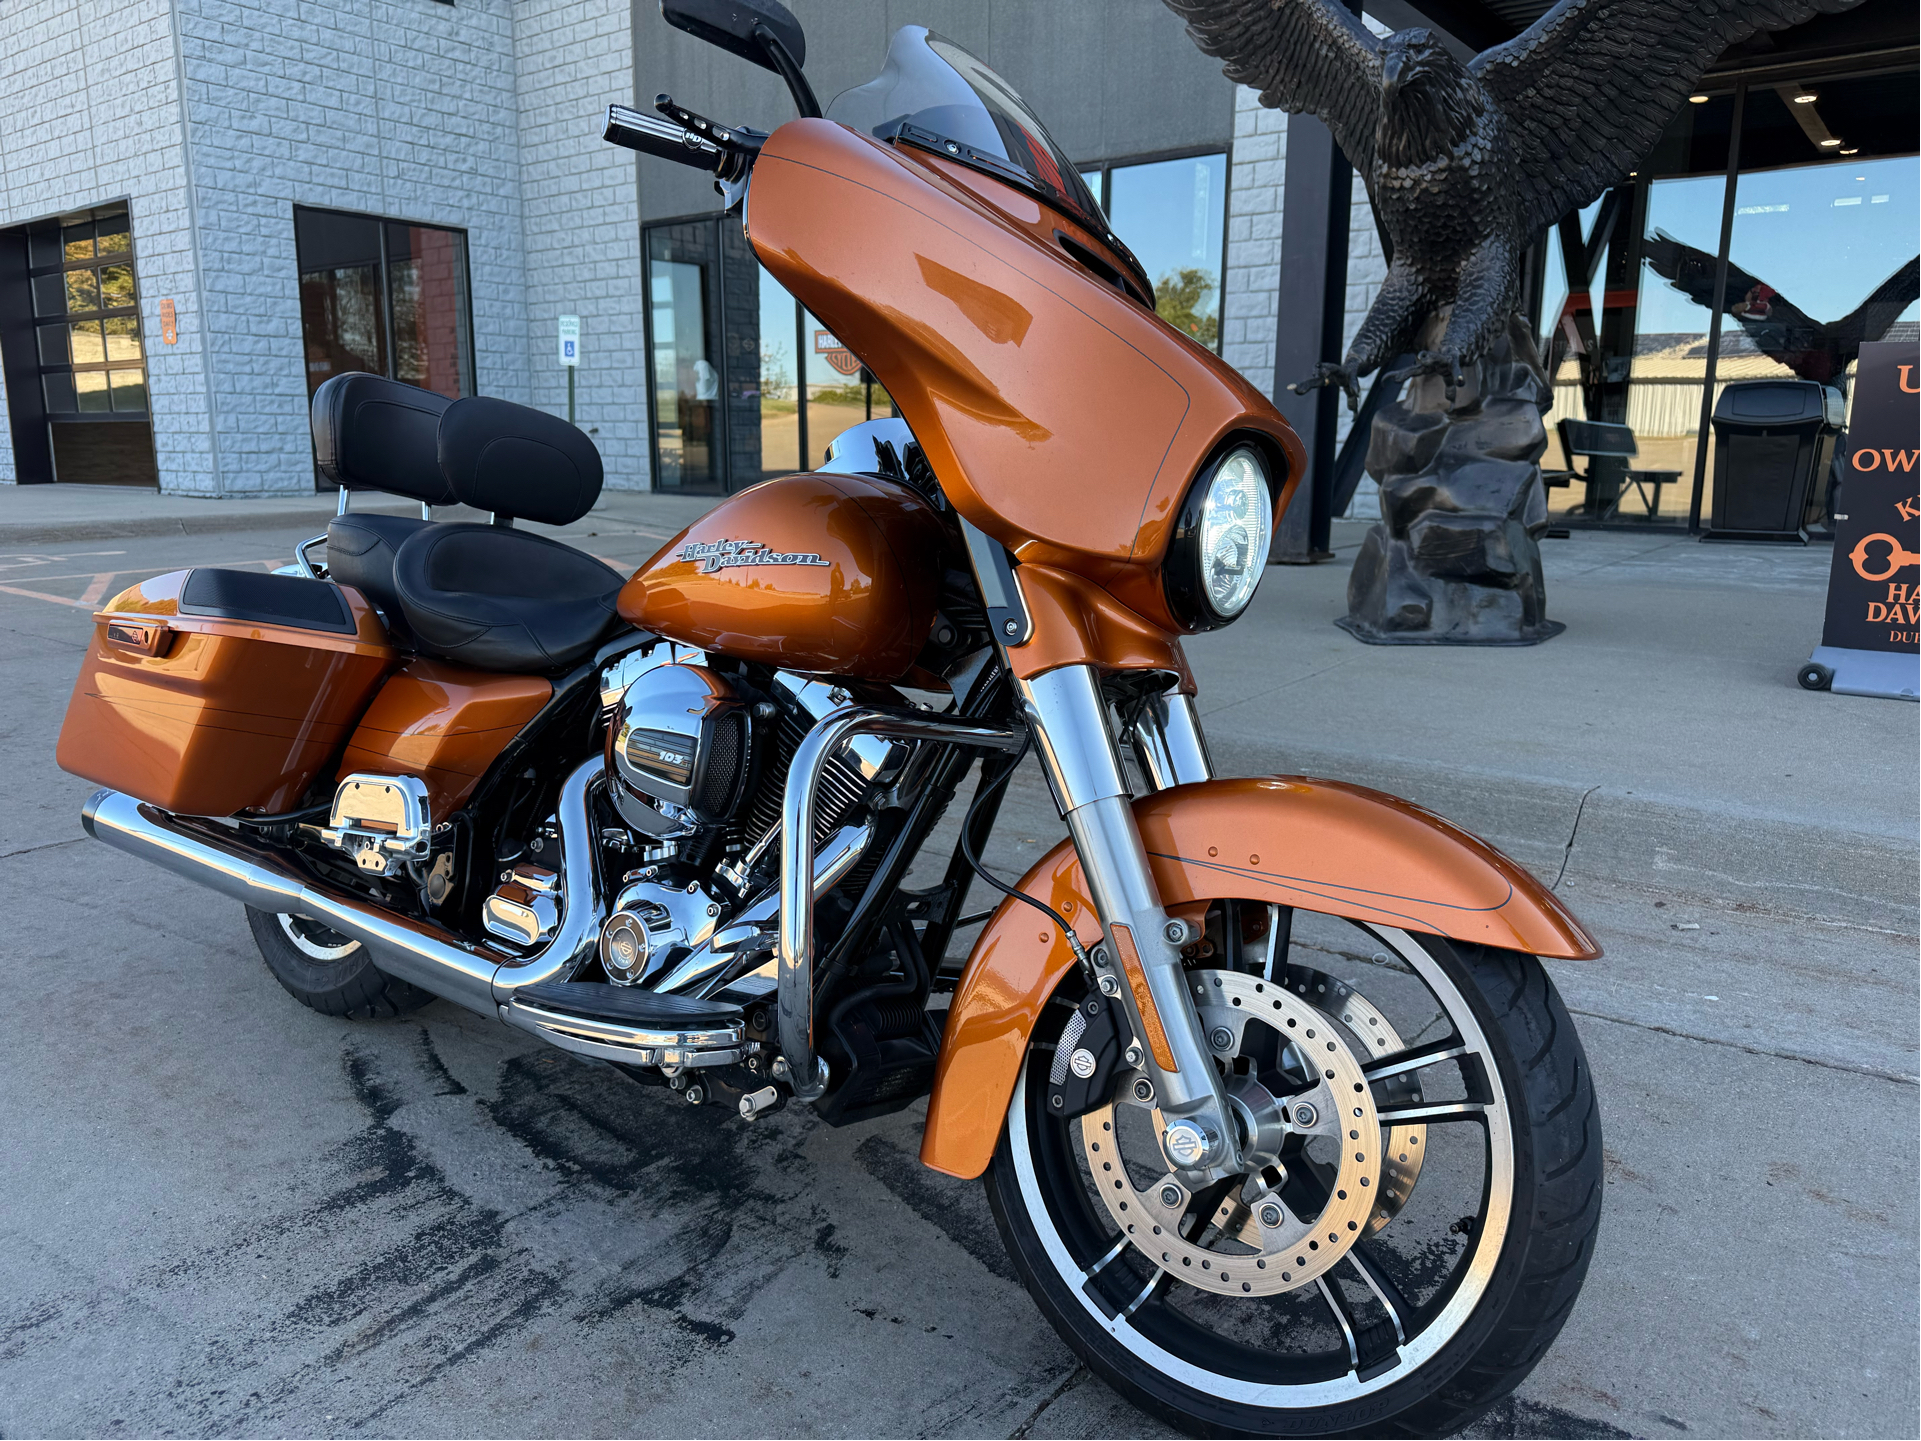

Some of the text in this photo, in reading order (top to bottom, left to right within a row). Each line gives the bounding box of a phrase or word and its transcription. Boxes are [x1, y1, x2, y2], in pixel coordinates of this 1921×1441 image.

[1894, 494, 1920, 522] K
[676, 538, 764, 563] Harley
[701, 548, 831, 574] Davidson
[659, 751, 684, 765] 103
[1284, 1398, 1389, 1430] DUNLOP
